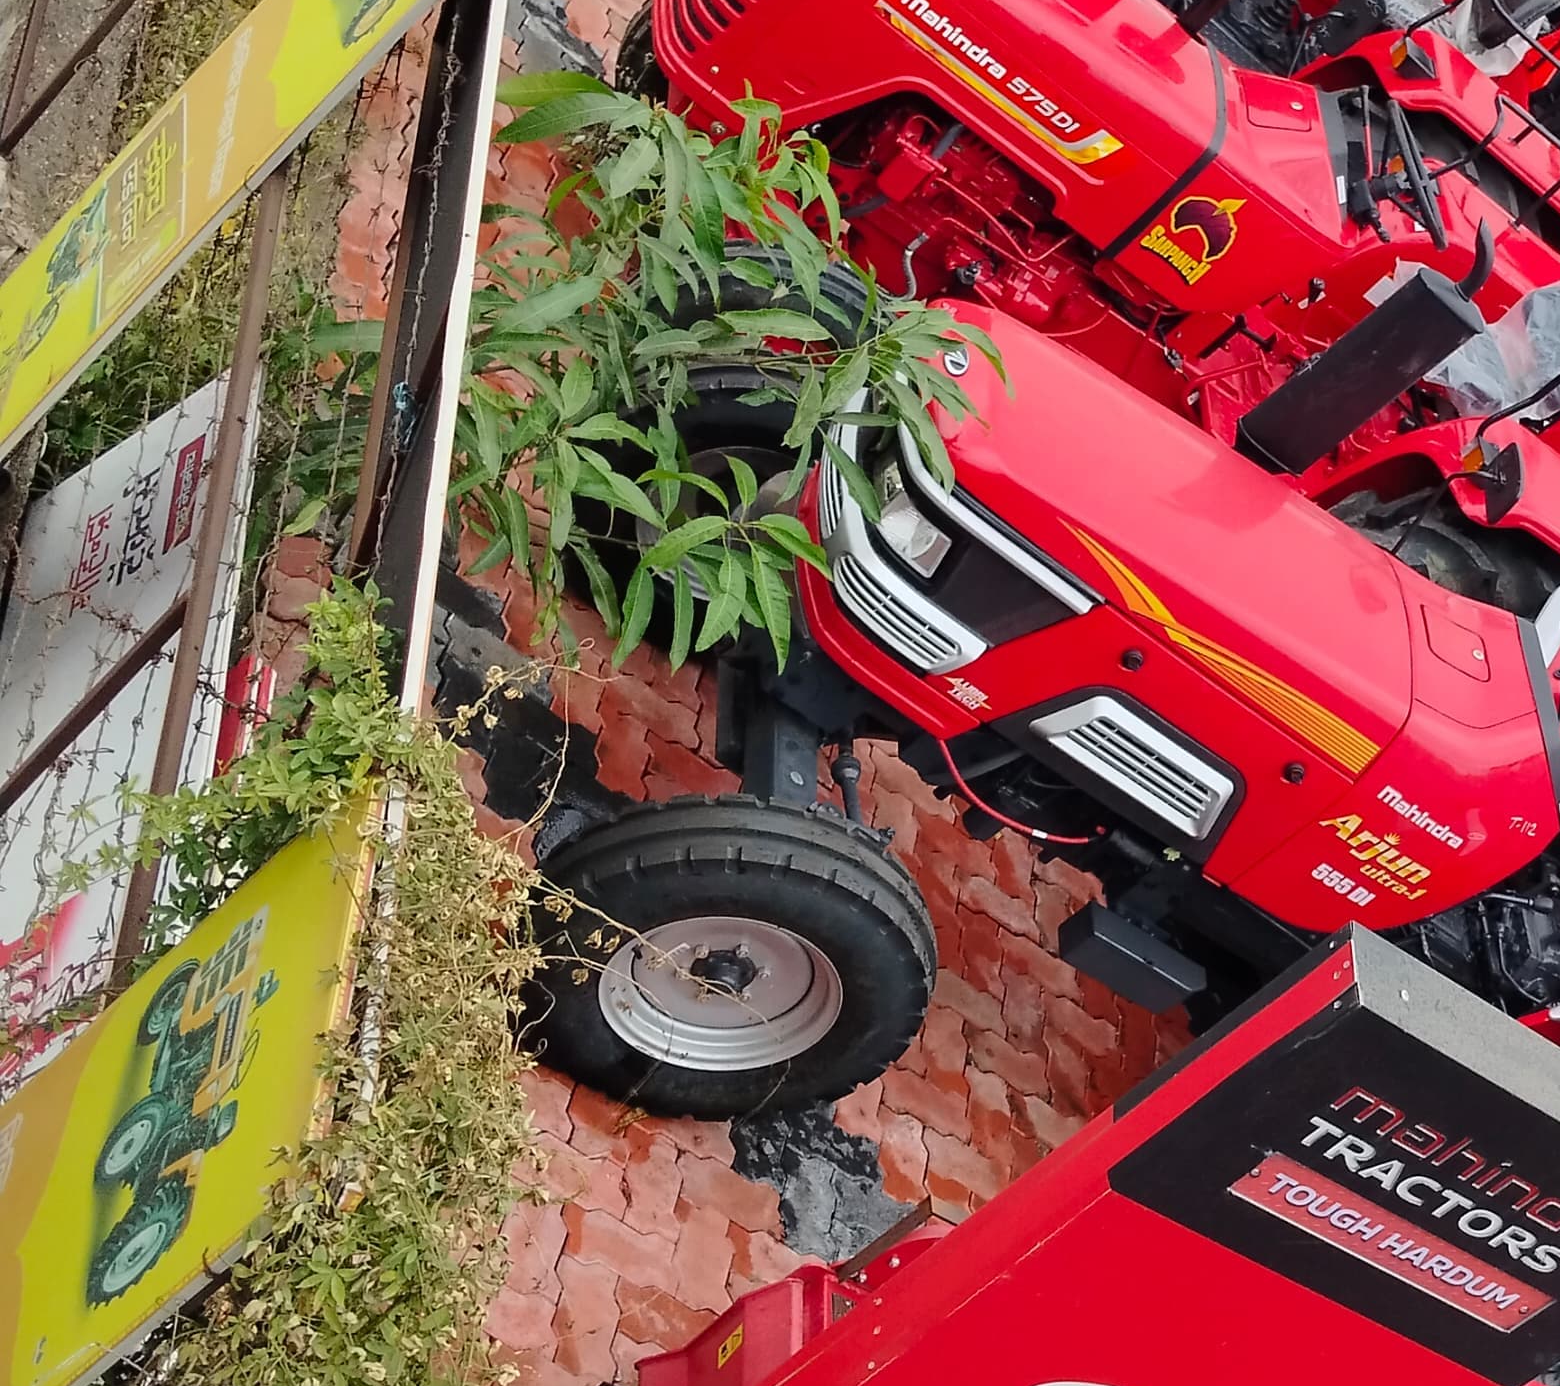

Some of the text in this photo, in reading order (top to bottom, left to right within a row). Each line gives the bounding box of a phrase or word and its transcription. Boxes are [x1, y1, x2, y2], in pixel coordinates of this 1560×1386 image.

[1006, 76, 1080, 134] 575DI
[1139, 225, 1212, 286] SARPANCH
[1377, 785, 1465, 851] Mahindra
[1319, 813, 1433, 885] Arjun
[1311, 862, 1377, 907] 555 DI
[1360, 864, 1427, 901] ultra-1
[1268, 1172, 1521, 1310] TOUGH HARDUM
